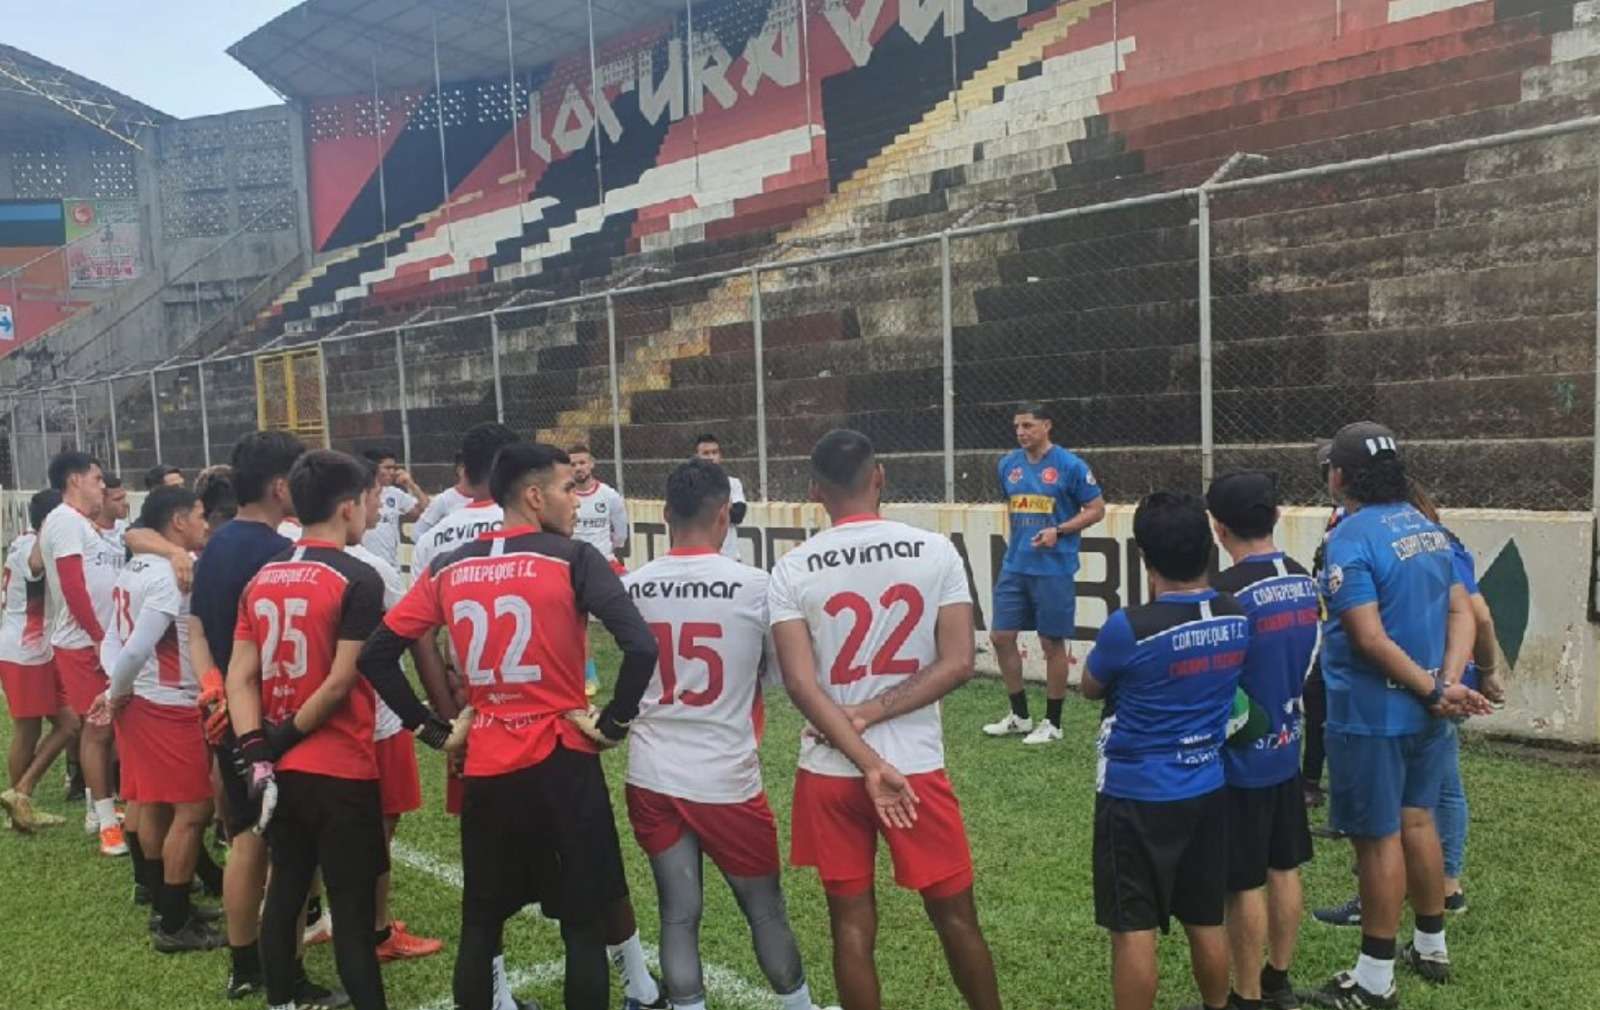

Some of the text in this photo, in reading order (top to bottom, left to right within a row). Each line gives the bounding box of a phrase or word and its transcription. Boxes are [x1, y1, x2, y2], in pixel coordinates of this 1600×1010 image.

[628, 580, 743, 599] nevimar
[808, 541, 925, 572] nevimar
[254, 597, 309, 681] 25
[452, 594, 542, 686] 22
[648, 621, 724, 707] 15
[823, 582, 925, 686] 22
